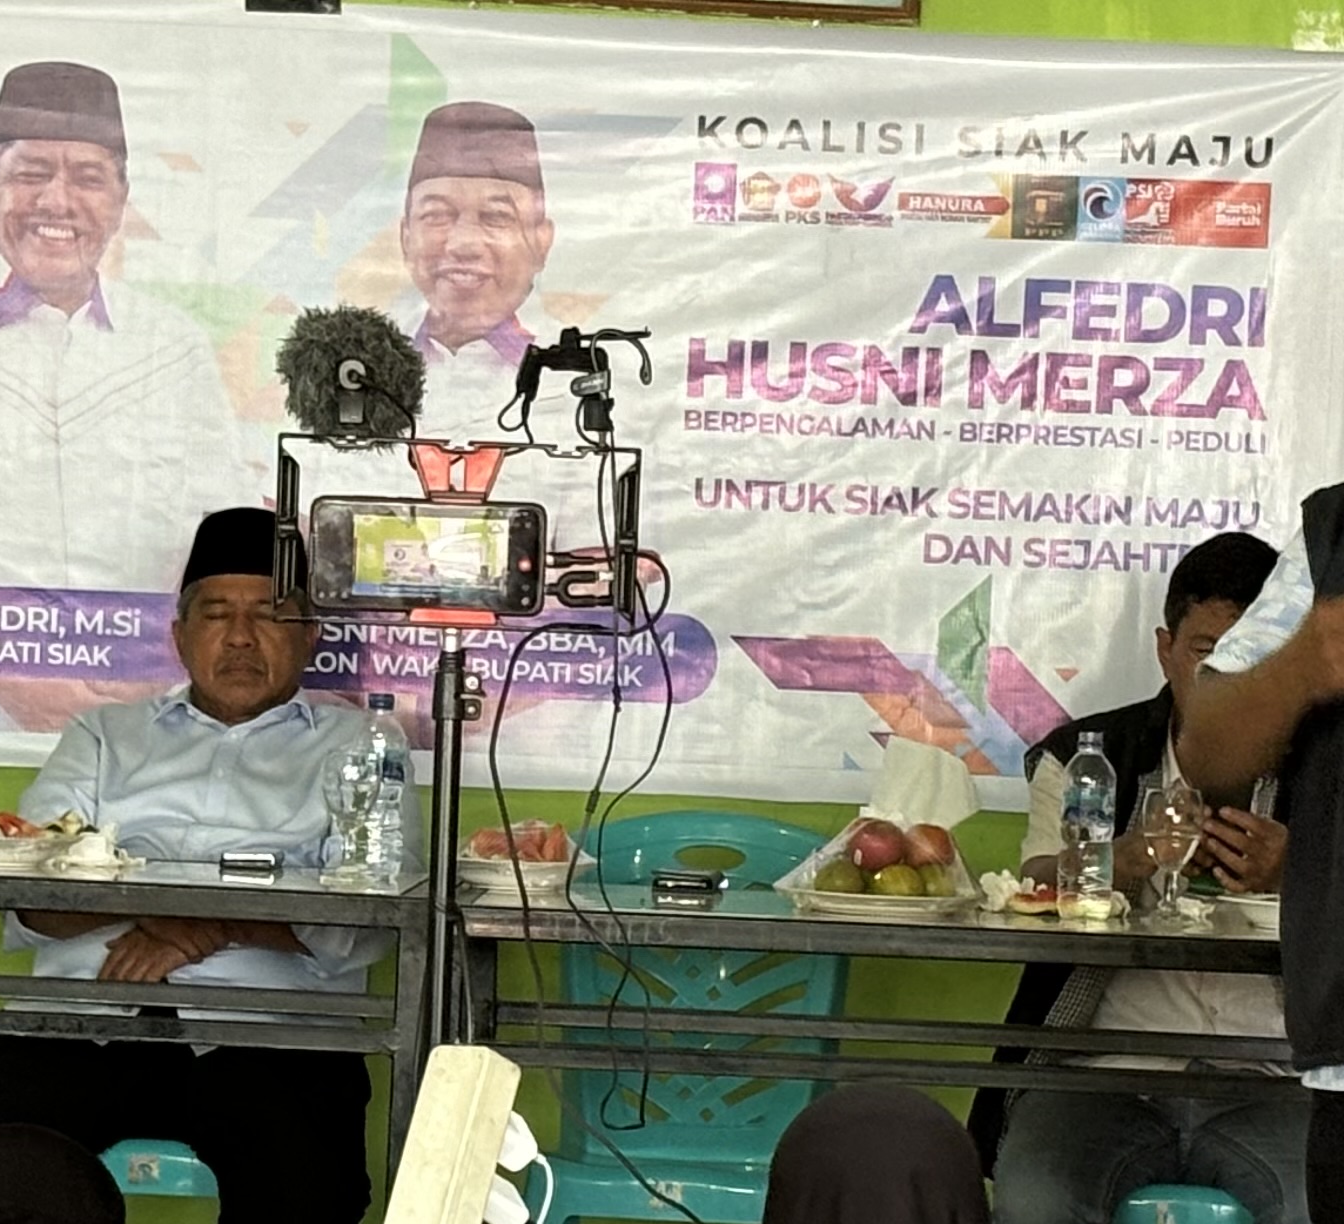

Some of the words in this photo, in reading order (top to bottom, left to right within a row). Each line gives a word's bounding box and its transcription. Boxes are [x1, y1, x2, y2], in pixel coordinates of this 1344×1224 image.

[697, 114, 925, 156] KOALISI
[957, 124, 1089, 164] SIAK
[1120, 132, 1275, 169] MAJU
[908, 196, 986, 212] HANURA
[1126, 183, 1153, 198] PSI
[694, 205, 736, 222] PAN
[785, 211, 822, 225] PKS
[1215, 201, 1262, 214] Partai
[1215, 214, 1261, 227] Buruh
[908, 274, 1267, 348] ALFEDRI
[685, 337, 942, 409] HUSNI
[968, 349, 1268, 421] MERZA
[683, 409, 936, 441] BERPENGALAMAN
[959, 421, 1143, 450] BERPRESTASI
[1166, 430, 1267, 455] PEDULI
[694, 478, 837, 516] UNTUK
[845, 484, 937, 519] SIAK
[947, 488, 1134, 527] SEMAKIN
[1144, 494, 1261, 528] MAJU
[923, 534, 1012, 567] DAN
[1023, 537, 1192, 573] SEJAHT
[75, 607, 141, 638] M.Si
[48, 642, 111, 668] SIAK
[317, 623, 377, 643] SNI
[387, 626, 514, 652] MEZA,
[617, 631, 676, 657] MM
[372, 653, 439, 678] WAK
[472, 657, 571, 684] BUPATI
[576, 662, 643, 687] SIAK
